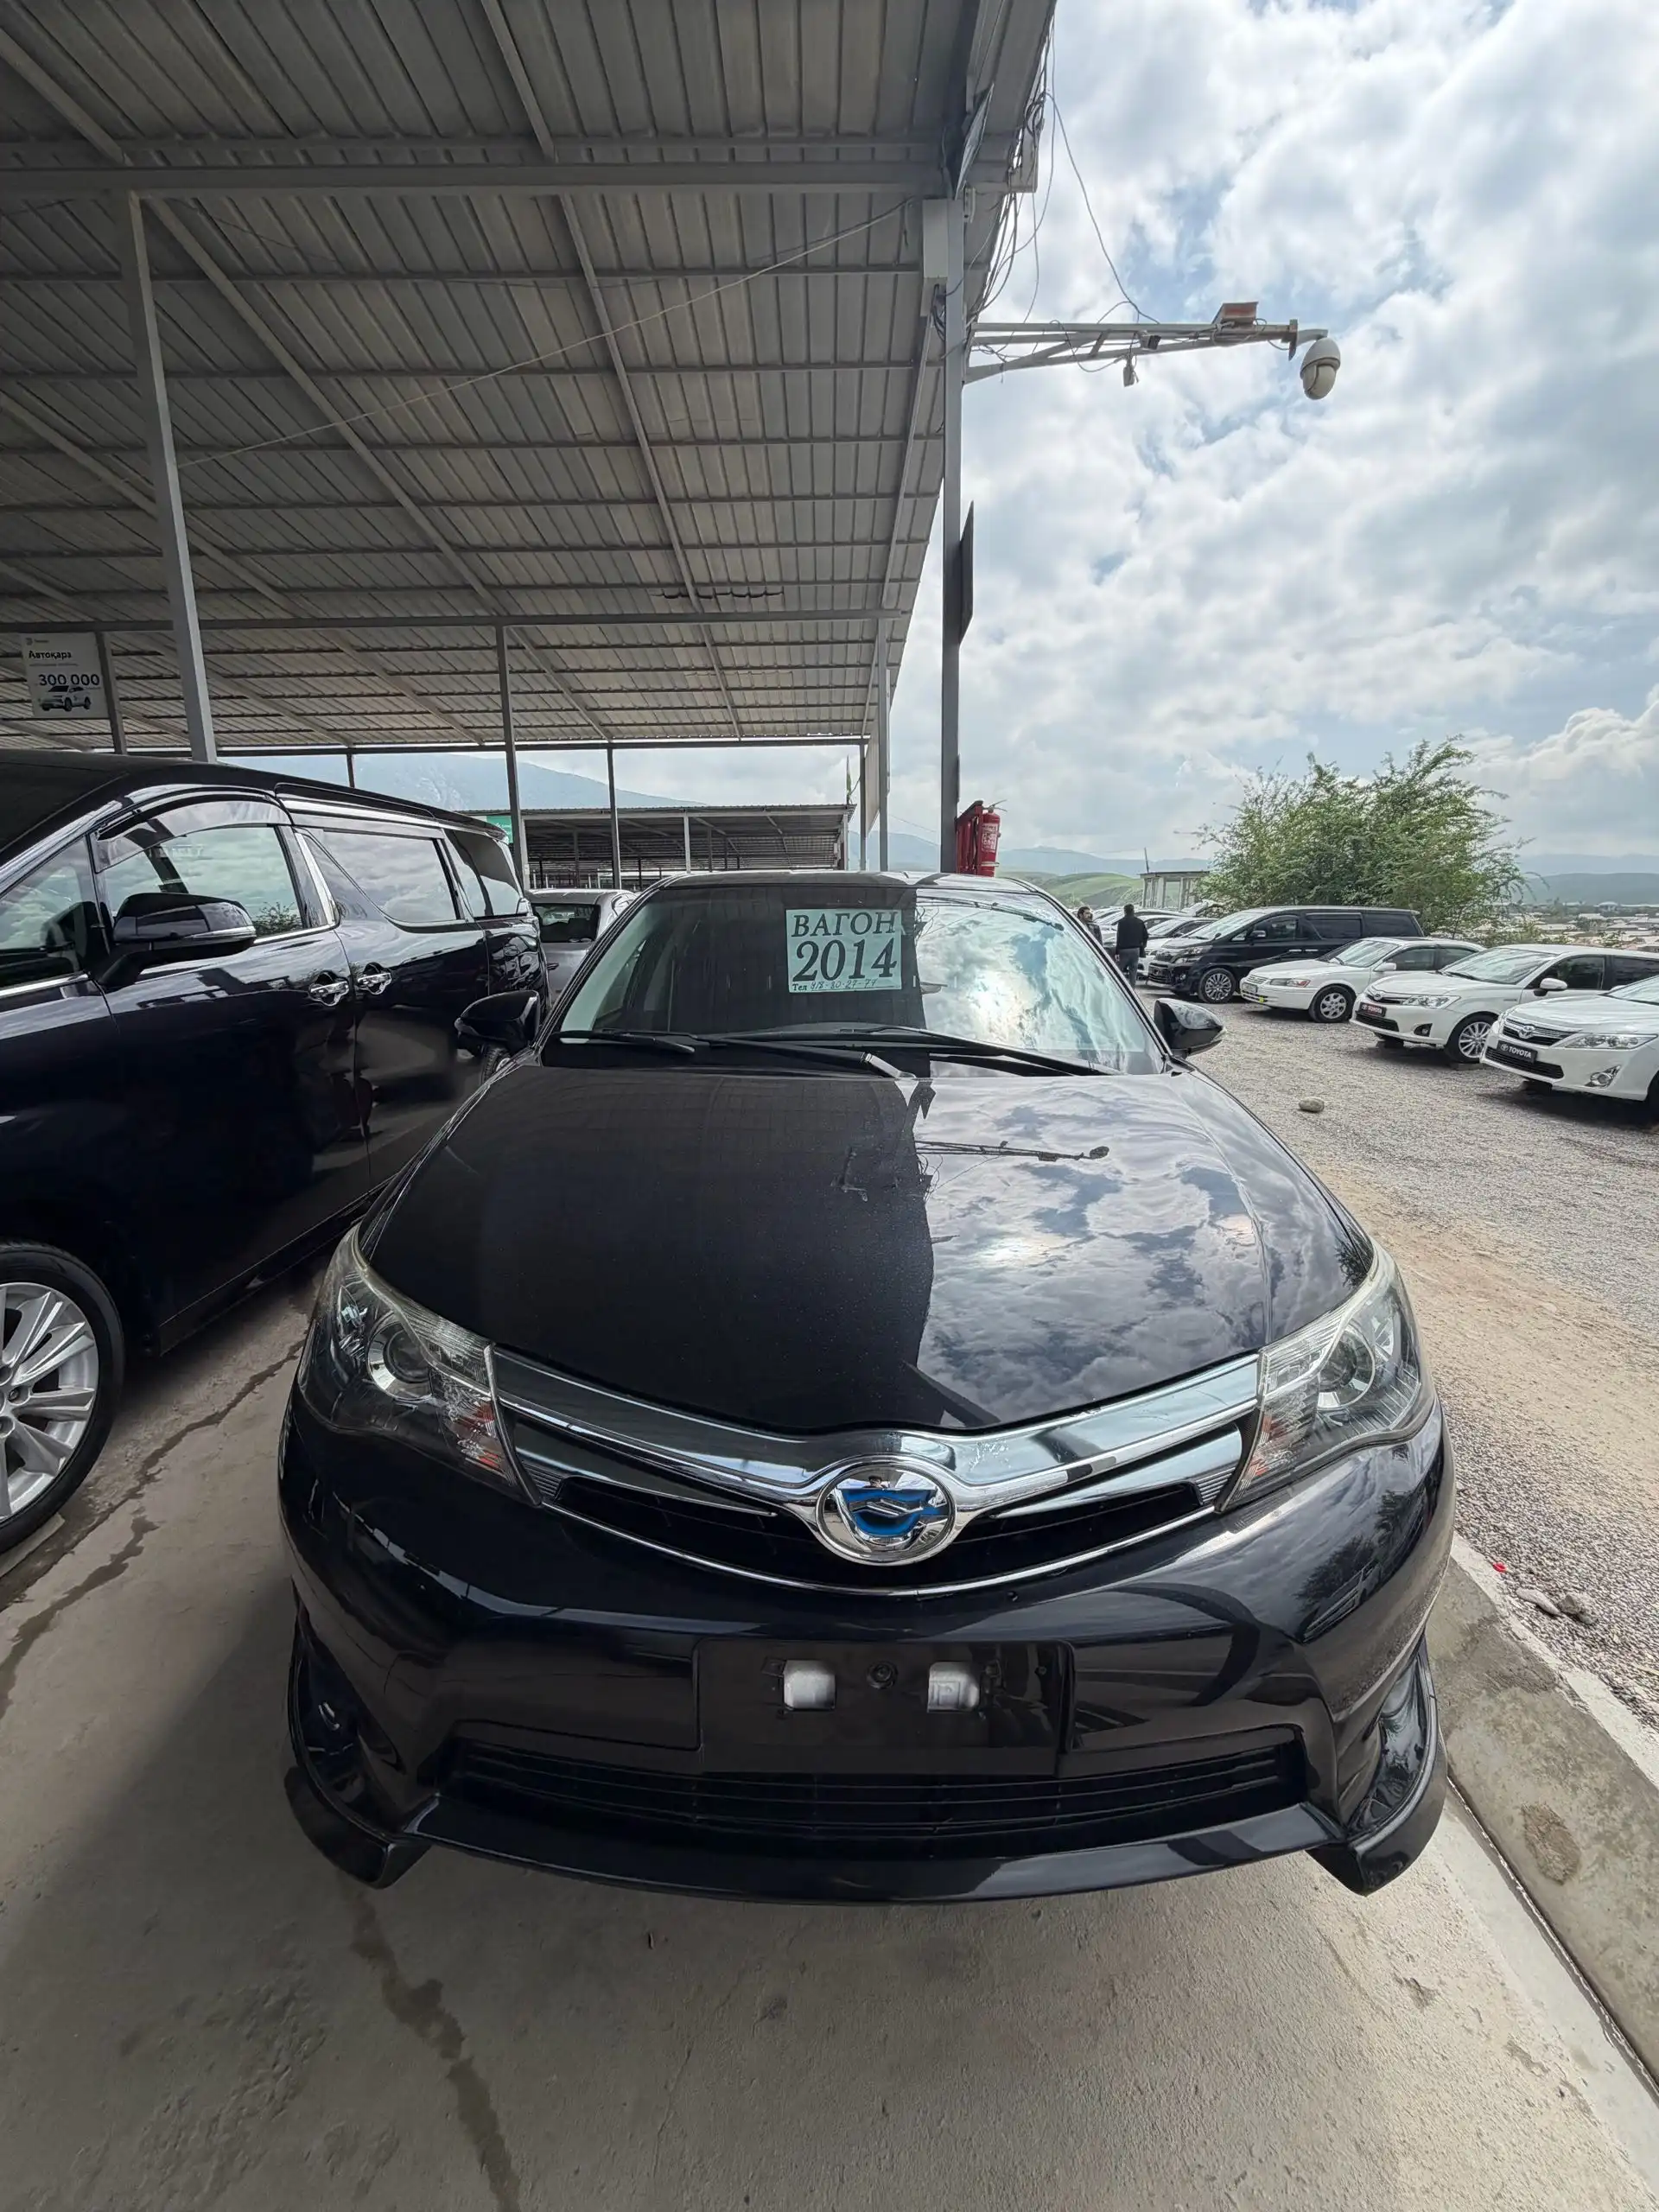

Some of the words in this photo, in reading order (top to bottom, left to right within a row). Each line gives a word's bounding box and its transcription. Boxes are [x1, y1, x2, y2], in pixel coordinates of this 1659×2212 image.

[38, 674, 67, 686] 300
[70, 674, 100, 686] 000
[791, 912, 899, 938] ВАГОН
[792, 938, 898, 982] 2014
[1509, 1046, 1531, 1058] TOYOTA
